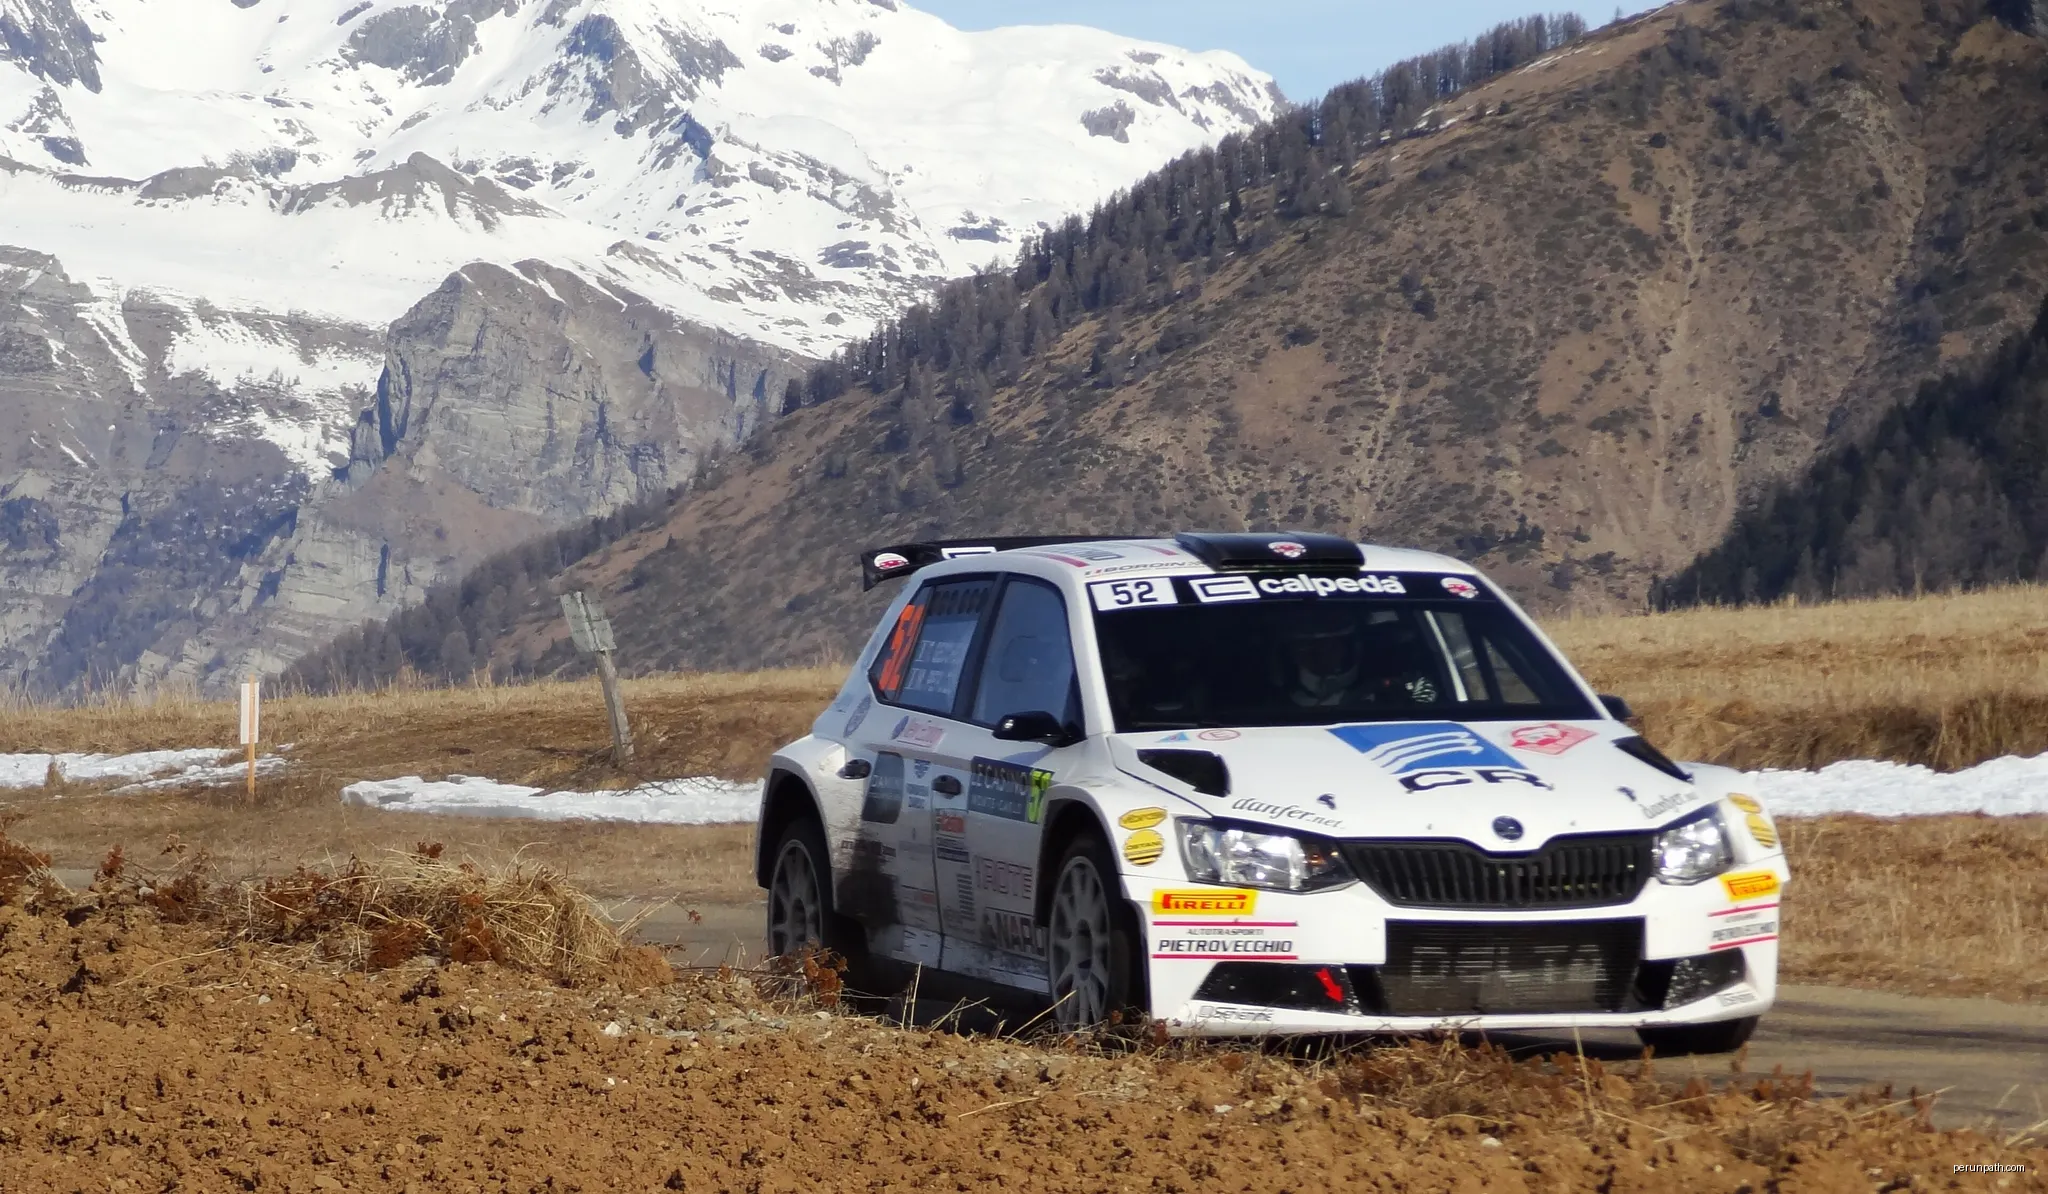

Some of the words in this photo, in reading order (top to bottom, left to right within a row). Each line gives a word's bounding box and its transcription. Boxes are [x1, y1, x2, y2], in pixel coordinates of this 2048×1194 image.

[1110, 581, 1159, 605] 52
[1231, 797, 1343, 828] danfer.net
[1162, 893, 1247, 910] PIRELLI
[1186, 928, 1264, 936] AUTOTRASPORTI
[1158, 939, 1293, 953] PIETROVECCHIO
[1411, 944, 1609, 984] DELTA
